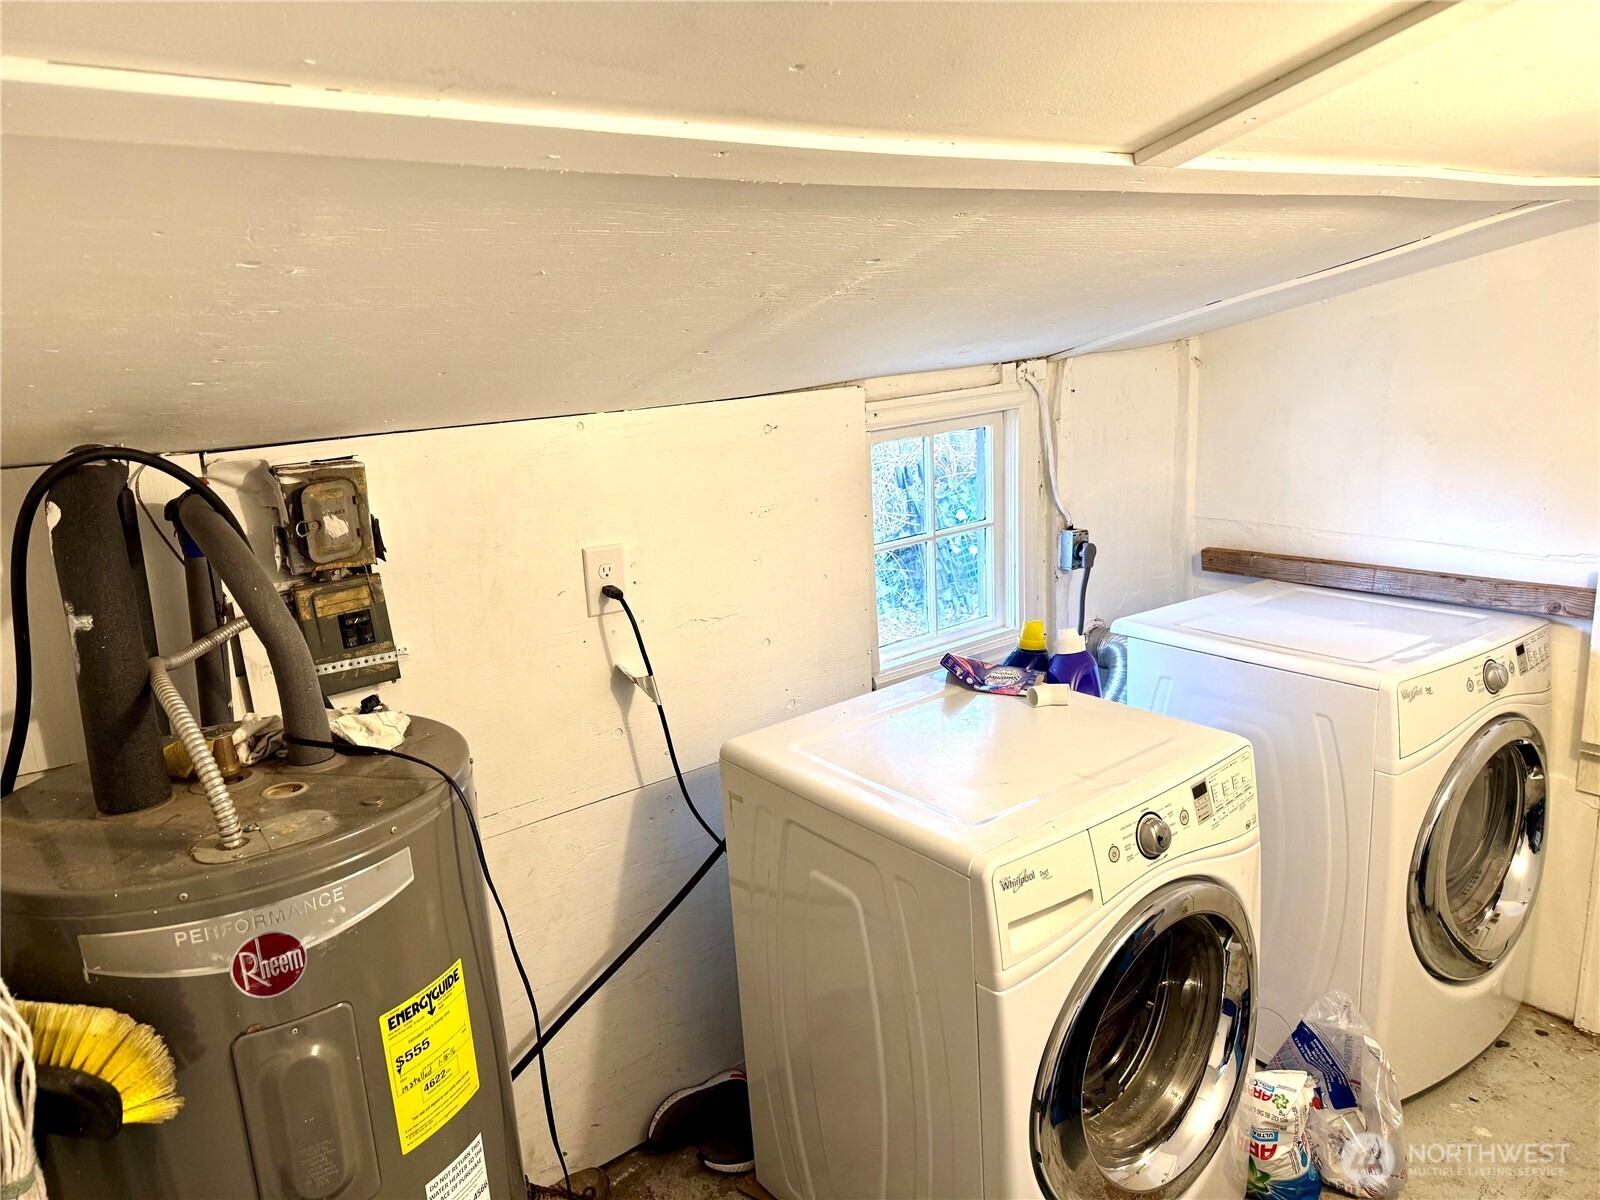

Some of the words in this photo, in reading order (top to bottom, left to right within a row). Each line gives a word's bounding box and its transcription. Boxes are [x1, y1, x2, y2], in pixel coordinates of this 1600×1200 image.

[999, 869, 1035, 893] Whirlpool
[174, 886, 344, 947] PERFORMANCE
[238, 937, 304, 991] Rheem
[387, 967, 460, 1032] ENERGYGUIDE
[395, 1037, 430, 1069] $555
[423, 1069, 446, 1092] 4622
[1252, 1130, 1273, 1138] ULTRA
[429, 1181, 439, 1192] DO
[439, 1170, 451, 1183] NOT
[452, 1151, 471, 1173] RETURN
[471, 1140, 481, 1153] THIS
[449, 1164, 468, 1185] HEATER
[468, 1156, 475, 1165] TO
[451, 1182, 459, 1193] OF
[459, 1157, 482, 1186] PURCHASE
